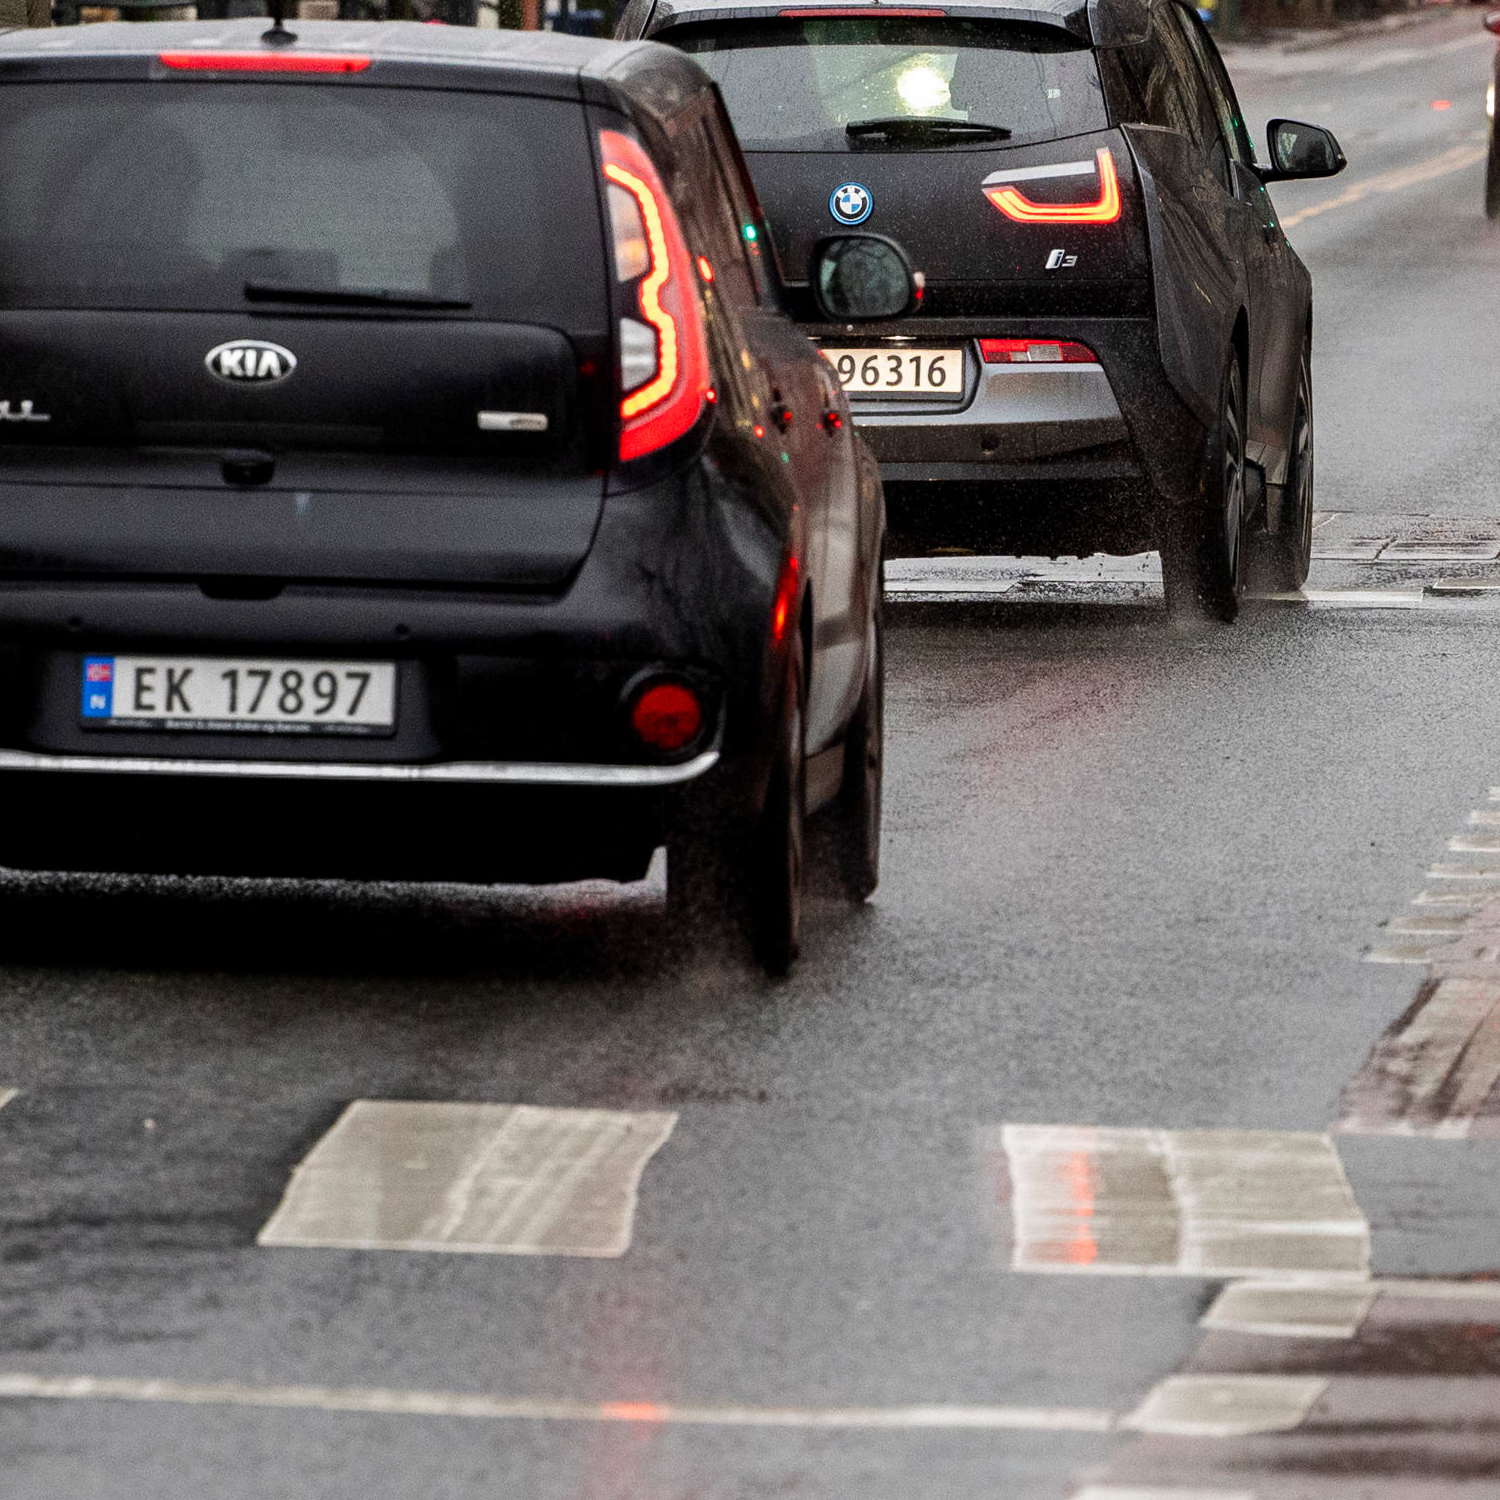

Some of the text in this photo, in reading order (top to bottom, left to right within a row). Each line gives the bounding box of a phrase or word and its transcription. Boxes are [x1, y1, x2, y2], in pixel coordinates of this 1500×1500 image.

[1045, 249, 1078, 269] i3
[219, 349, 282, 378] KIA
[837, 354, 947, 388] 96316
[133, 667, 372, 716] EK 17897
